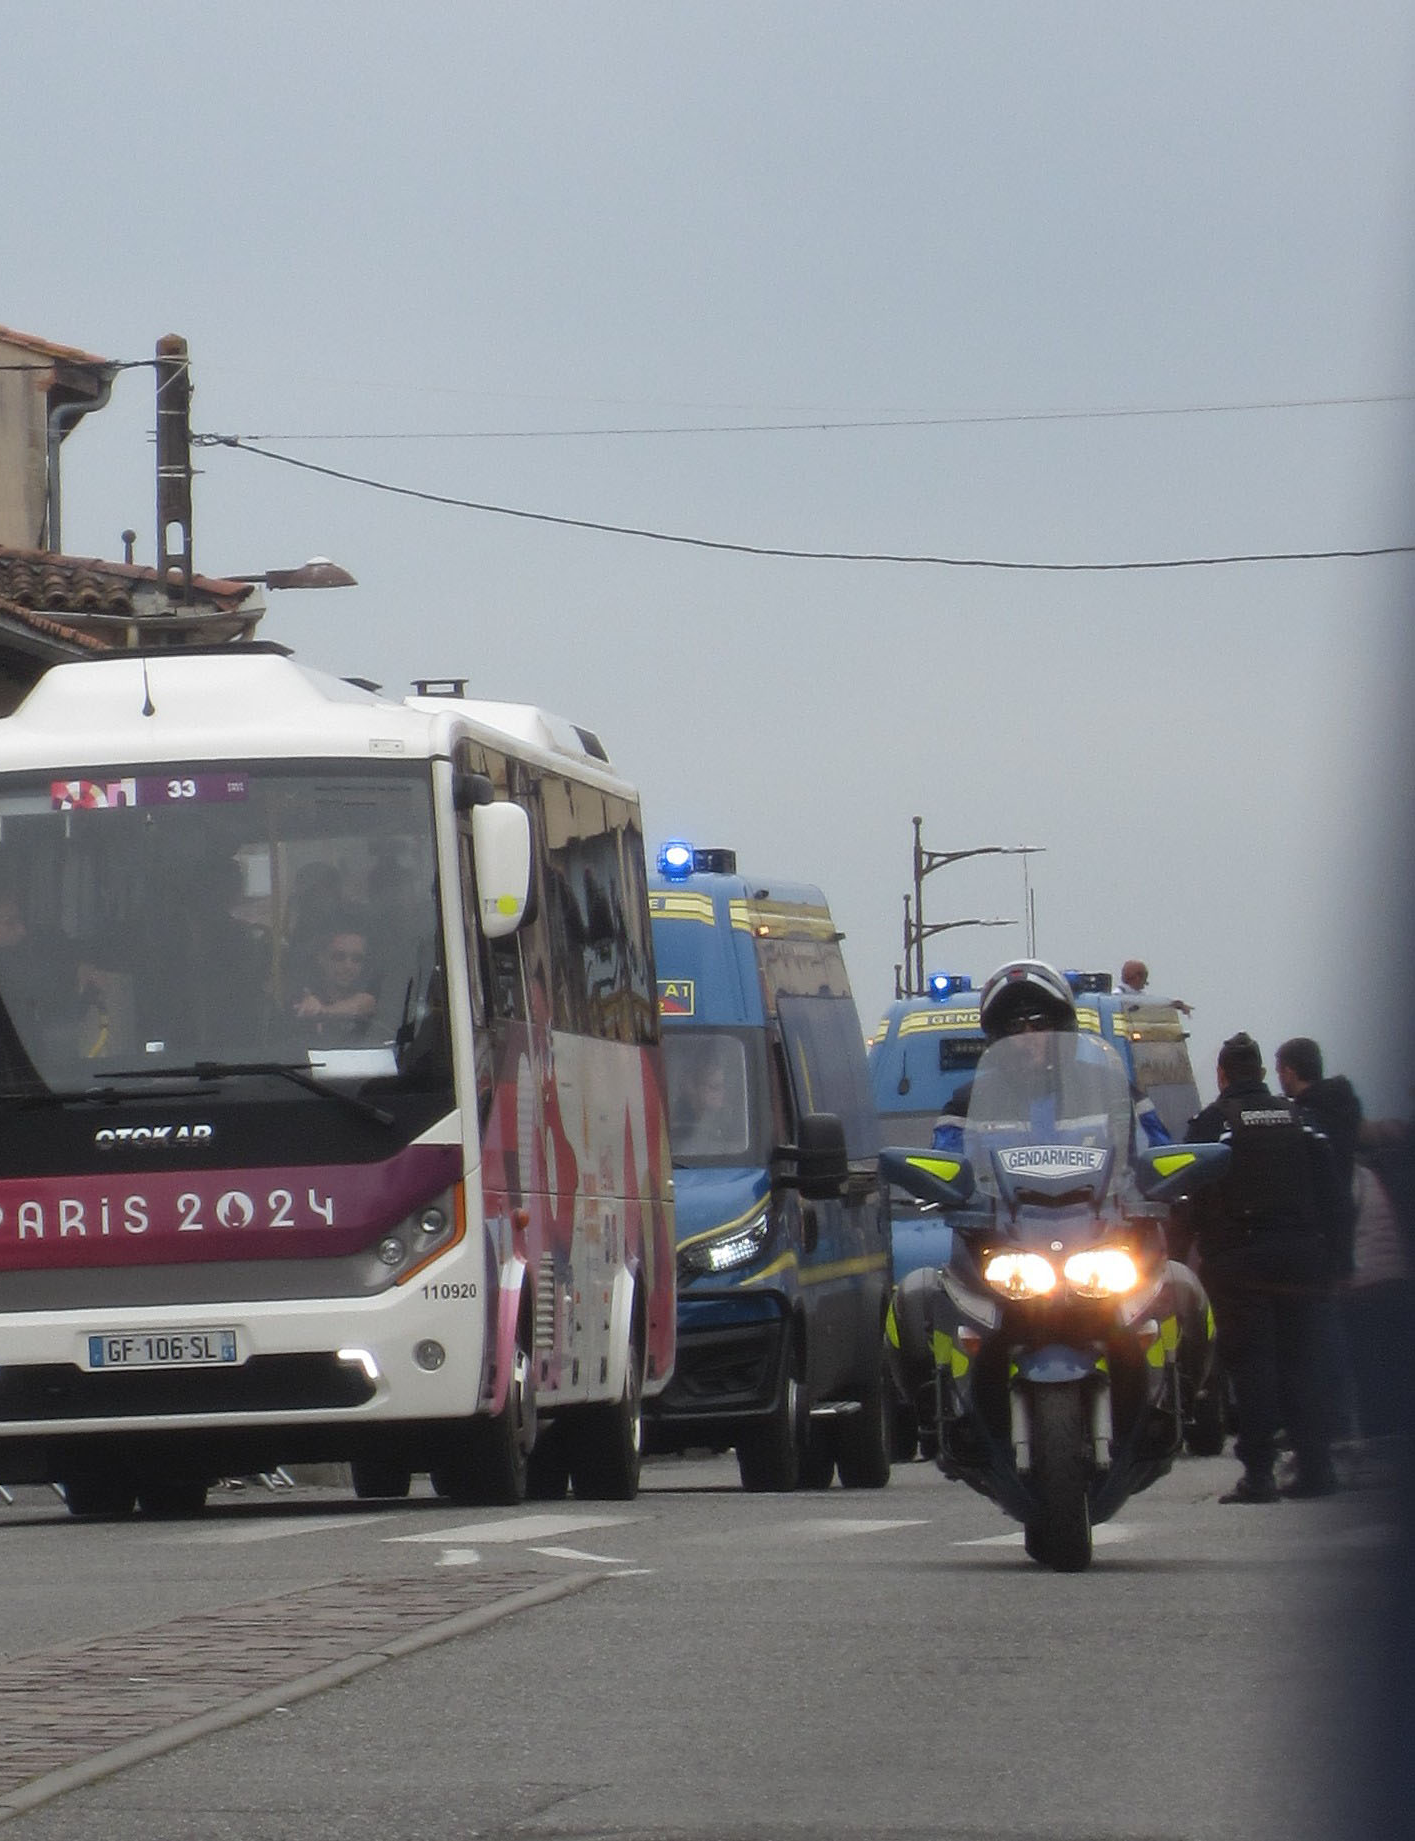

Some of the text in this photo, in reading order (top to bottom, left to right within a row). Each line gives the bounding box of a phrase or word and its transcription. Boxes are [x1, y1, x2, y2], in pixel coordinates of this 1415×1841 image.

[167, 780, 196, 798] 33
[94, 1124, 213, 1149] OTOKAR
[1009, 1150, 1096, 1168] GENDARMERIE
[421, 1283, 478, 1300] 110920
[107, 1336, 218, 1362] GF-106-SL
